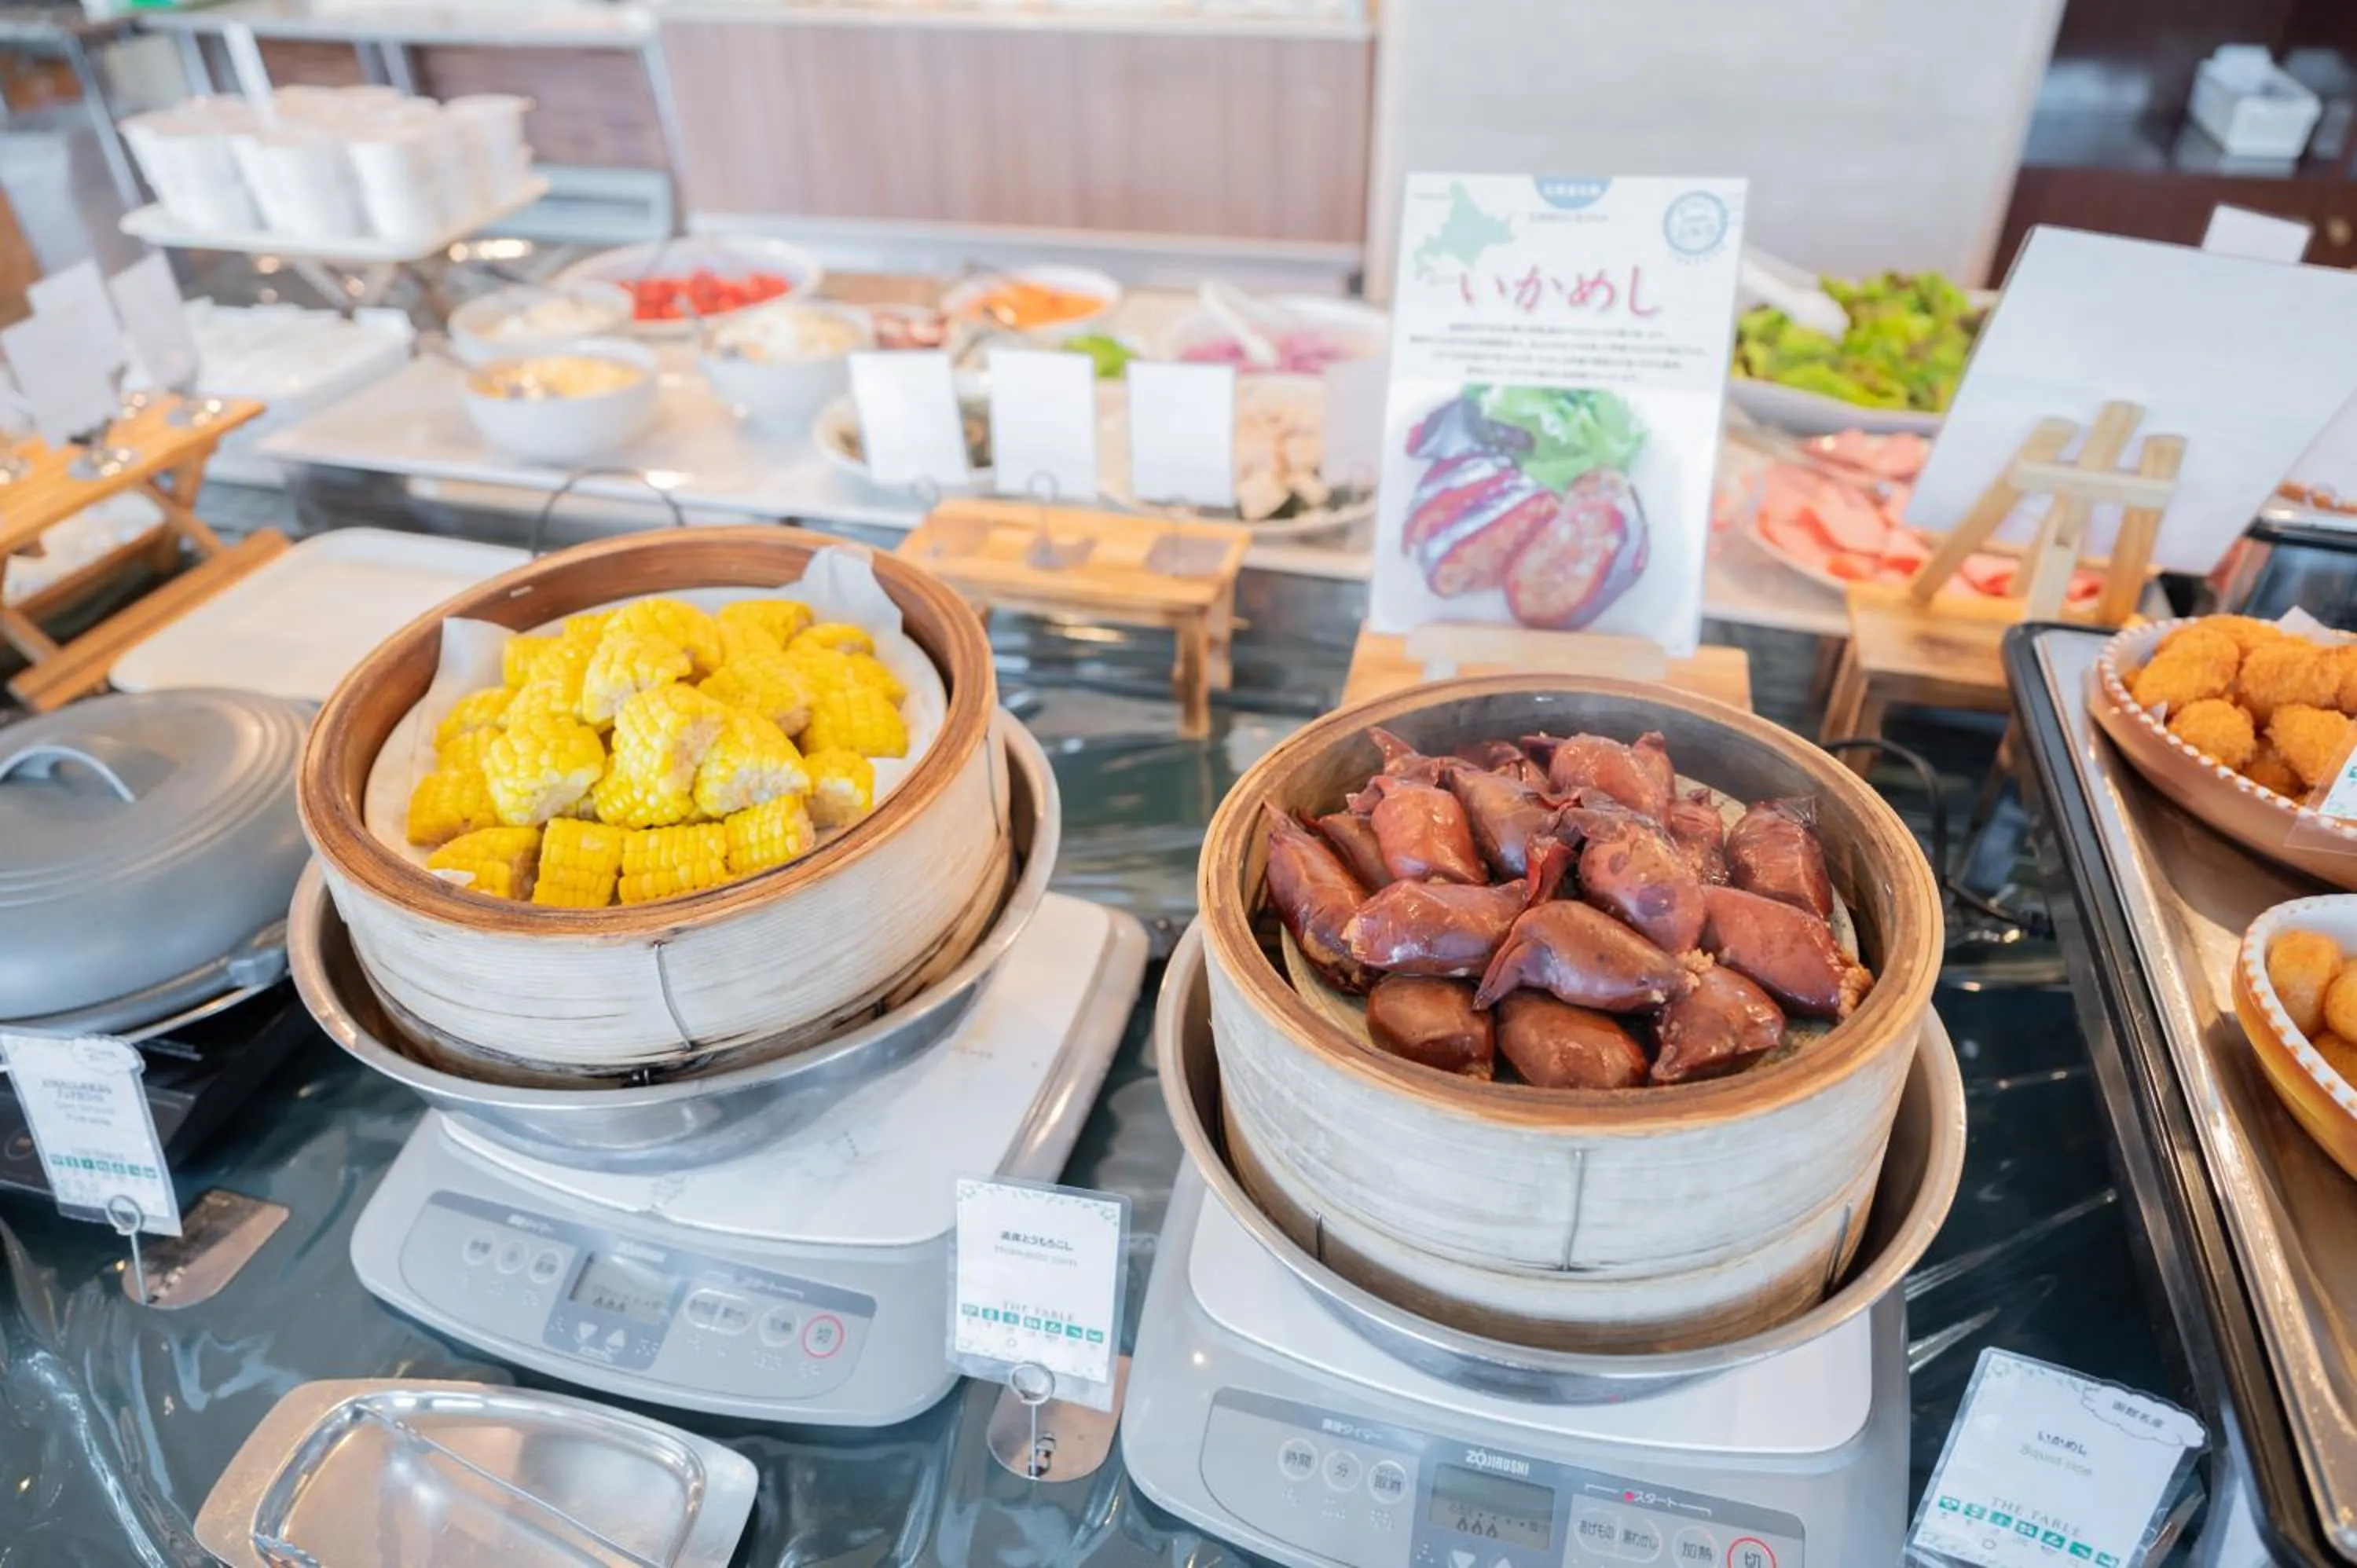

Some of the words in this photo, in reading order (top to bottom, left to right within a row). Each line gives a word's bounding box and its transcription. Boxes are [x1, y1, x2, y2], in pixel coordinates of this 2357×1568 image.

[1459, 264, 1662, 316] いかめし
[2037, 1430, 2088, 1455] いかめし
[1633, 1491, 1678, 1508] スタート
[1992, 1497, 2025, 1516] THE
[2031, 1508, 2082, 1537] TABLE
[1744, 1550, 1761, 1568] 切
